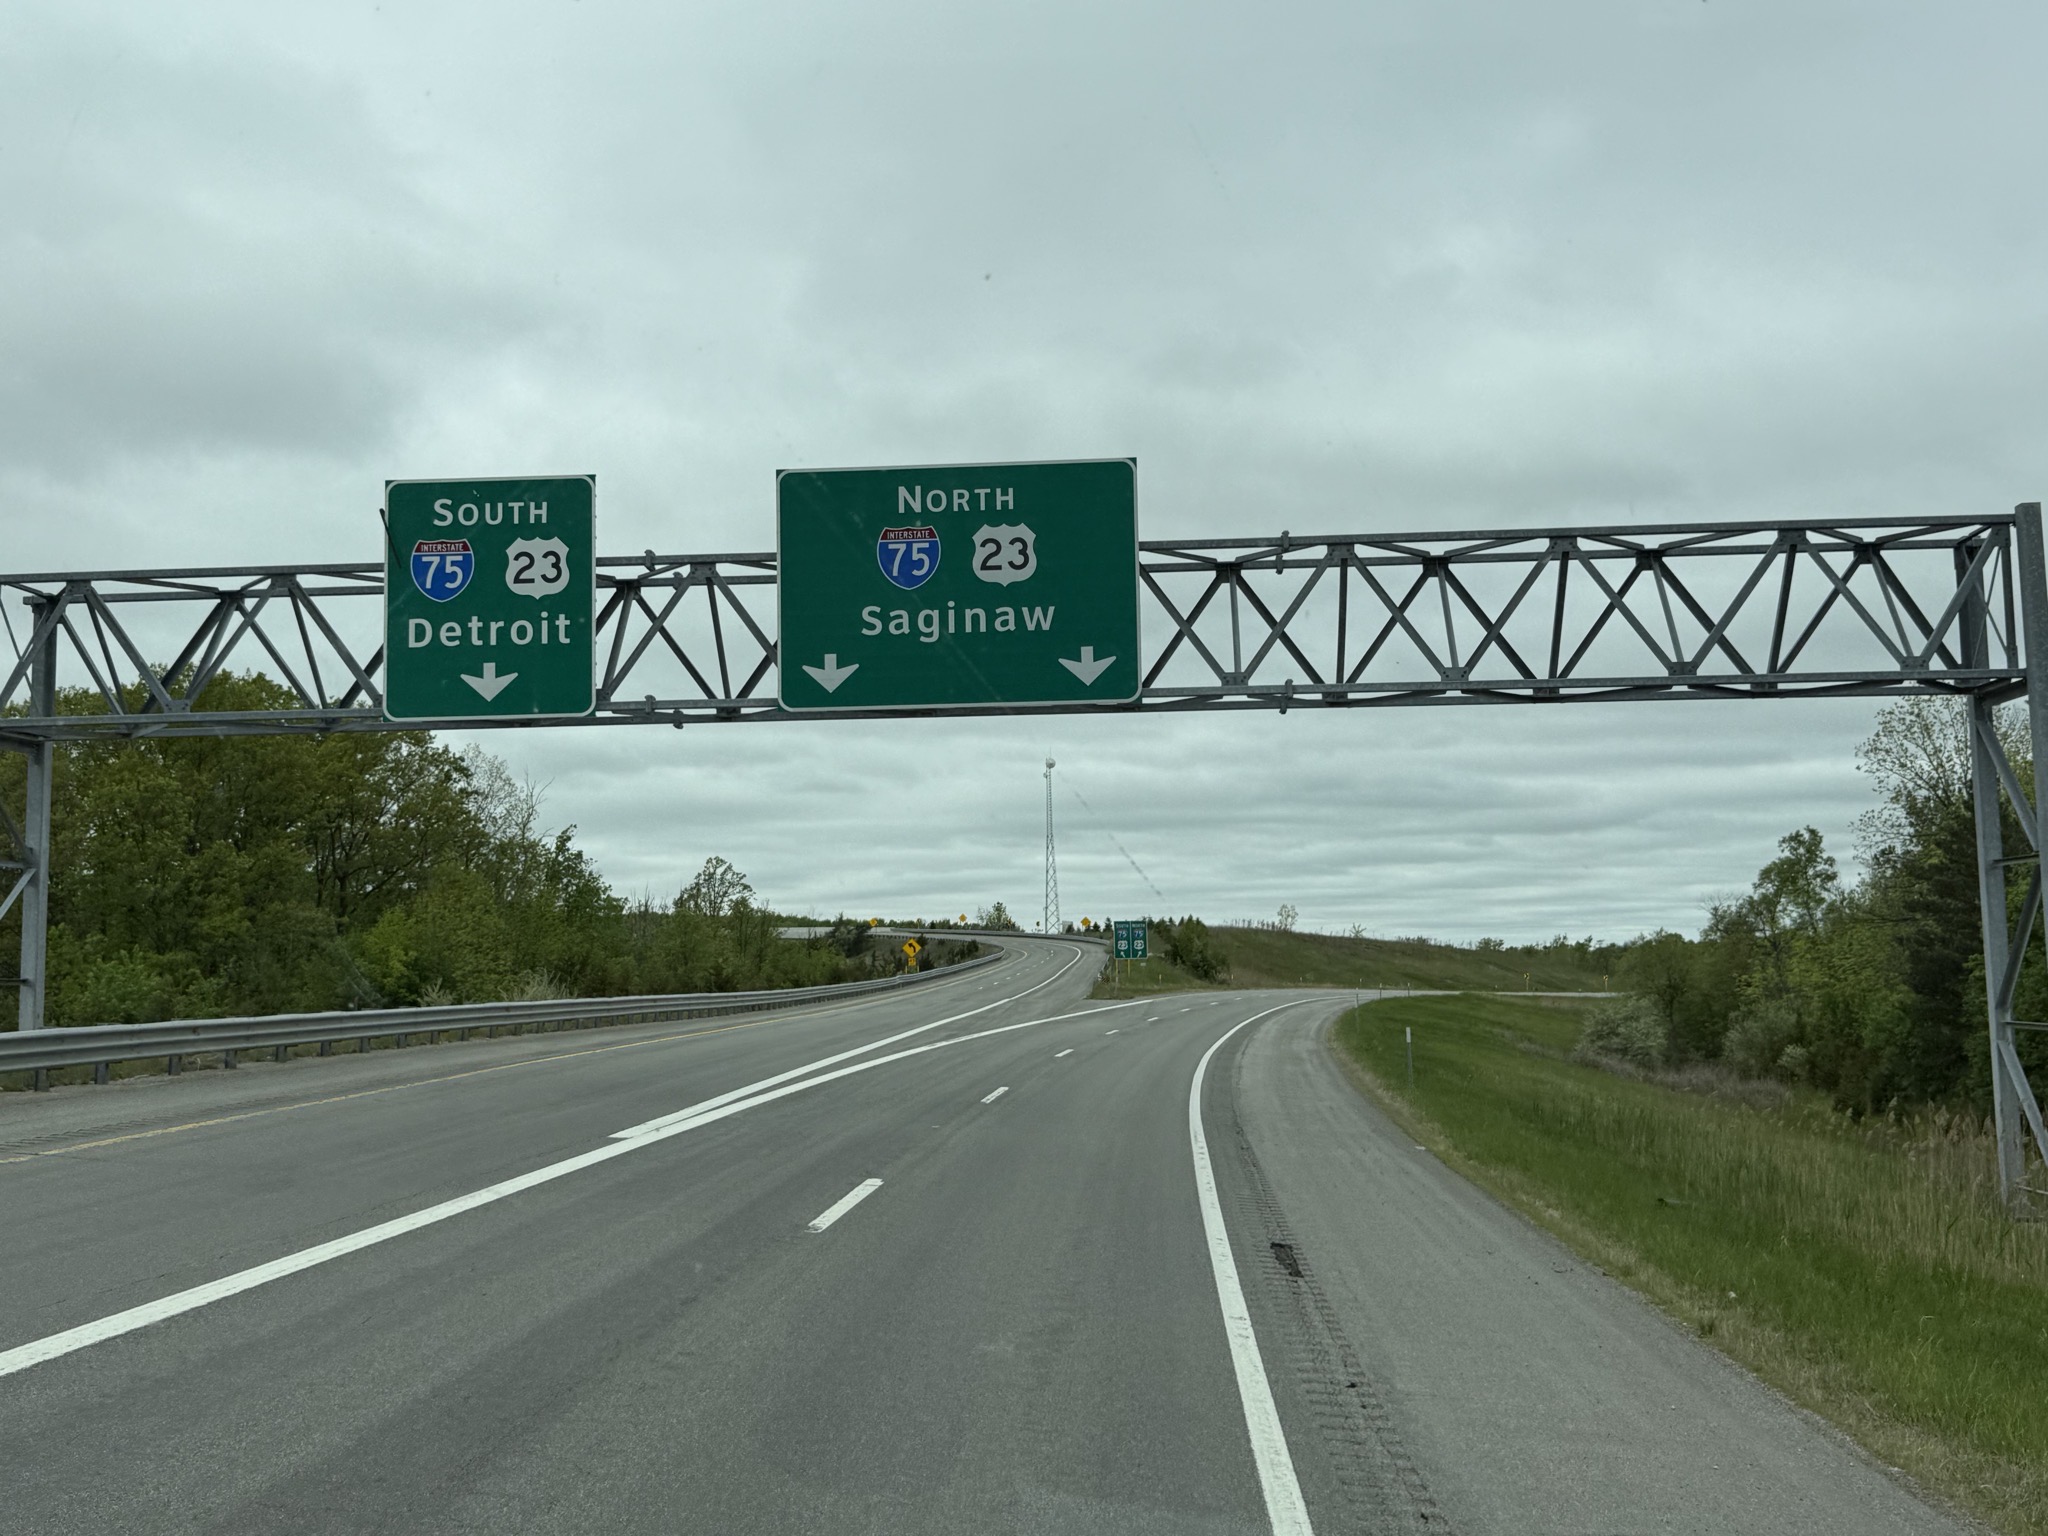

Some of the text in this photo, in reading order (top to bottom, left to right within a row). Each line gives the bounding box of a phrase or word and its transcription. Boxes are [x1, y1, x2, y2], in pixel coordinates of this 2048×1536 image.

[433, 498, 548, 526] SOUTH
[898, 485, 1014, 514] NORTH
[420, 543, 464, 552] INTERSTATE
[886, 529, 930, 540] INTERSTATE
[513, 550, 562, 584] 23
[888, 542, 930, 577] 75
[980, 537, 1029, 571] 23
[421, 555, 464, 589] 75
[408, 611, 571, 649] Detroit
[861, 600, 1055, 643] Saginaw
